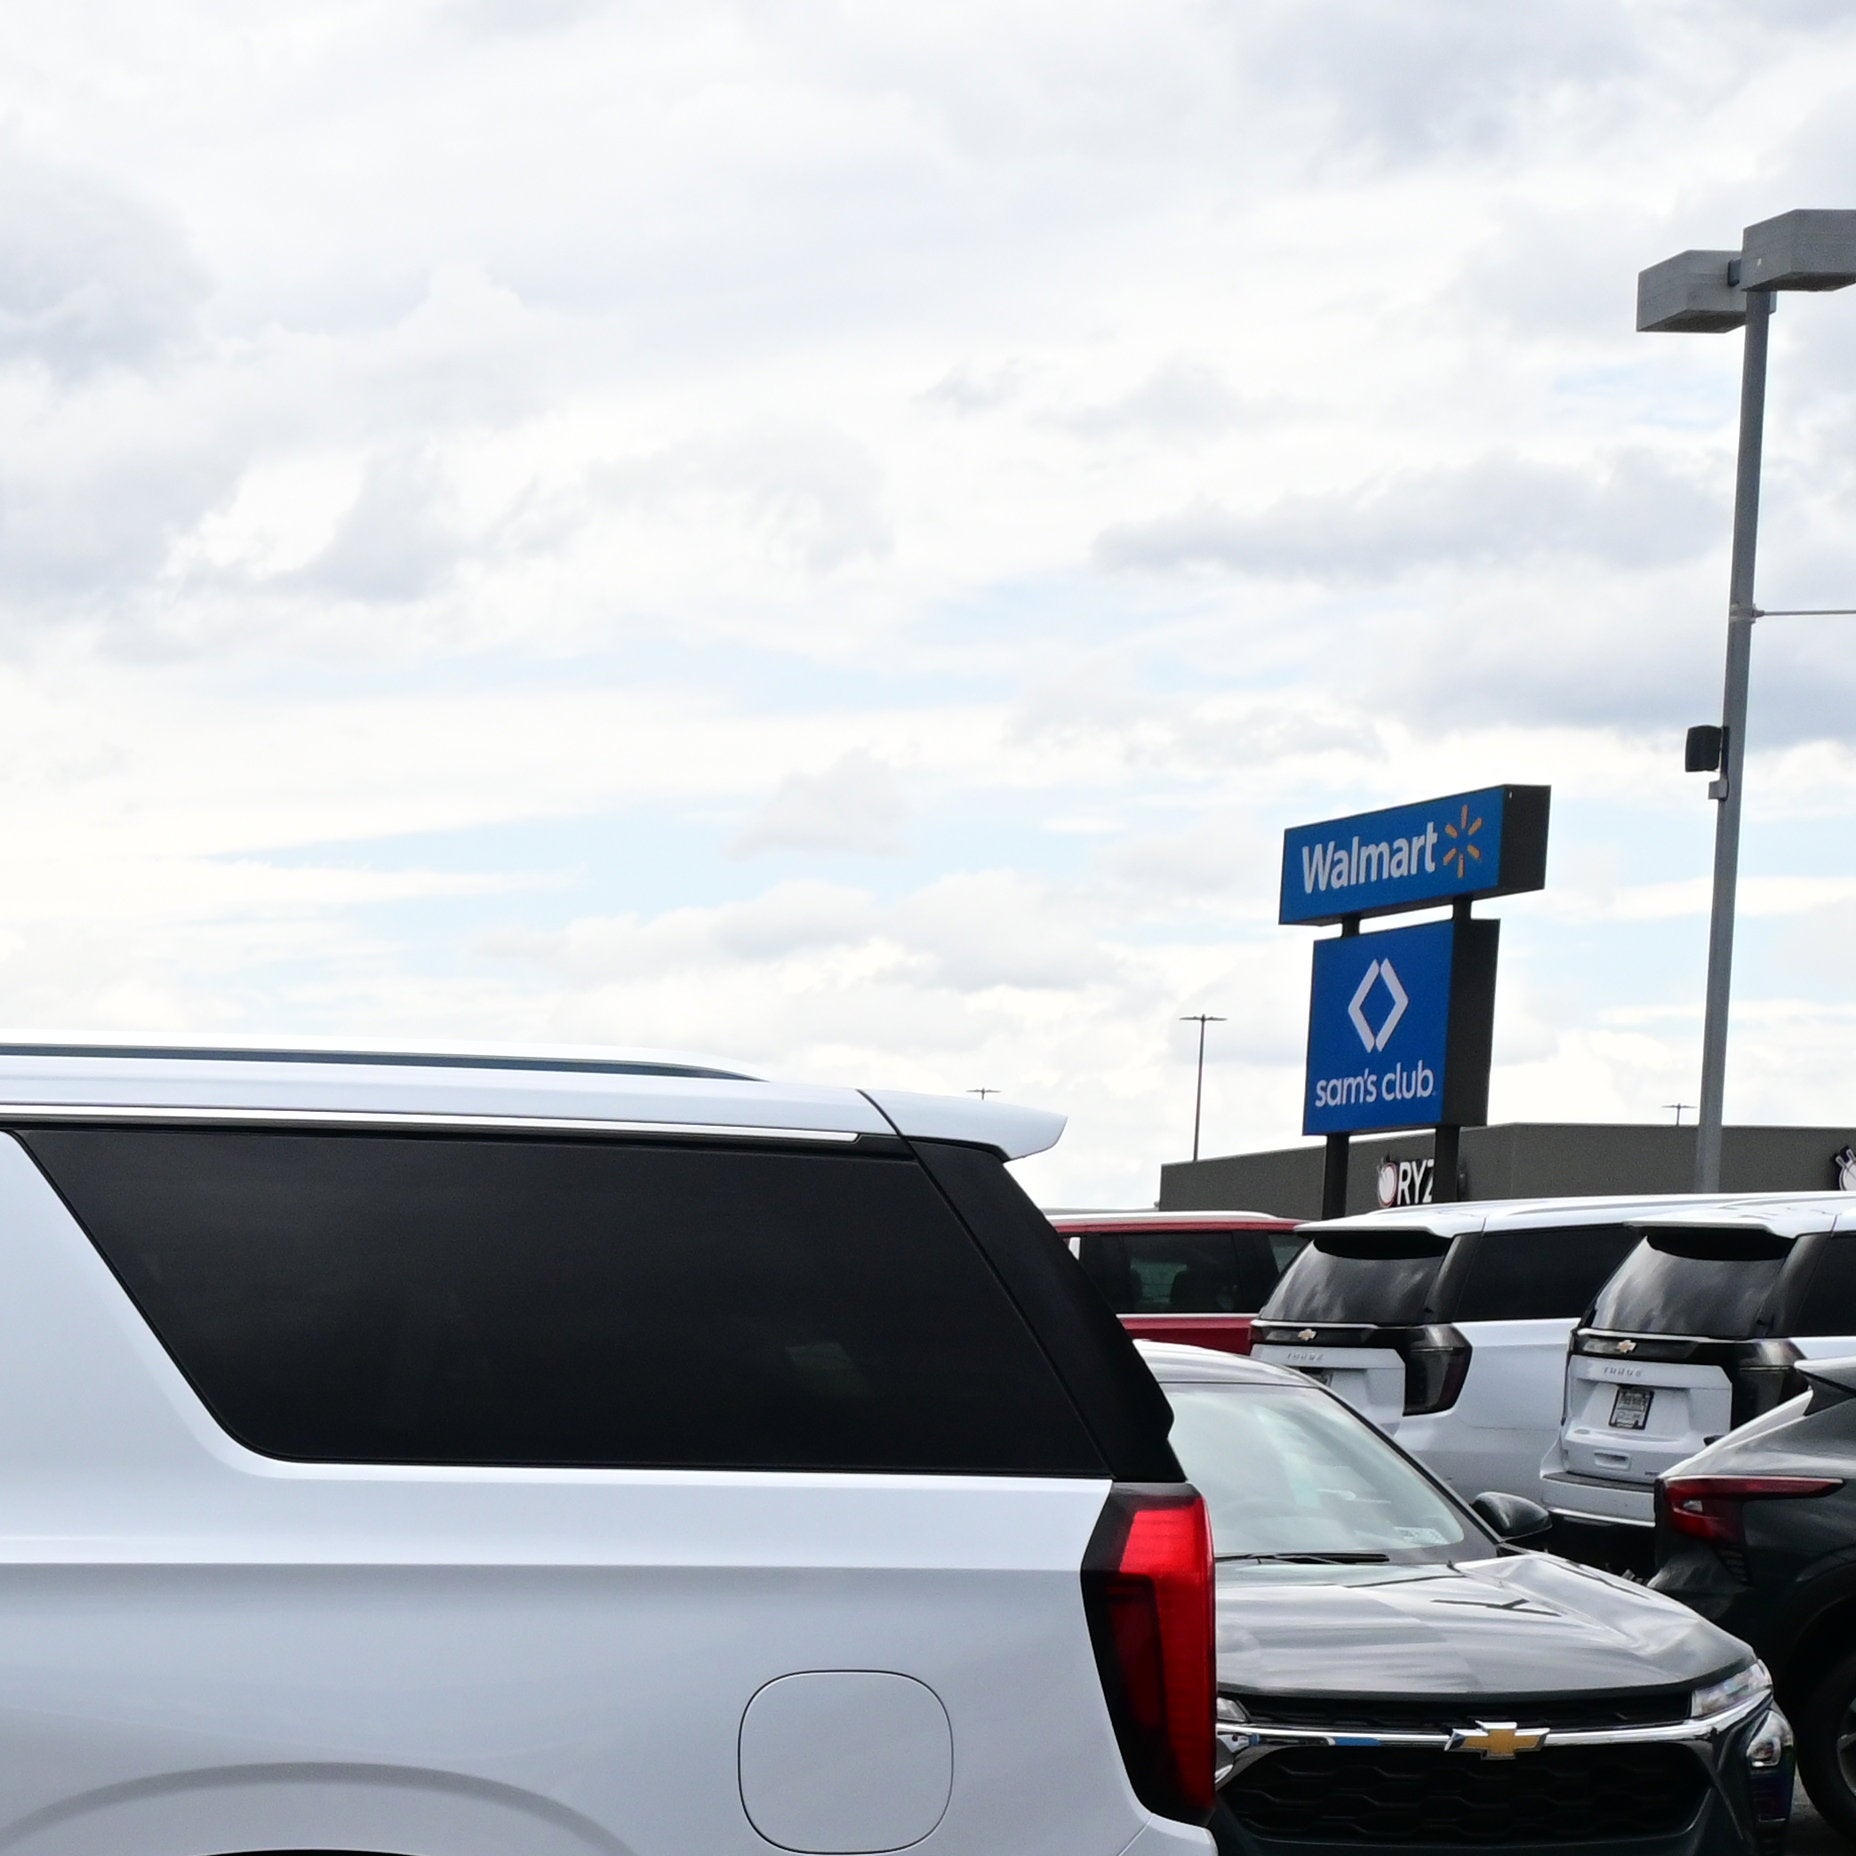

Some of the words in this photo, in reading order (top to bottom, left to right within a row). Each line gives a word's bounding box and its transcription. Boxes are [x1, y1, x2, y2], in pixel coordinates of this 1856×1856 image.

[1301, 821, 1439, 894] Walmart
[1314, 1067, 1378, 1108] sam's
[1381, 1059, 1435, 1102] club
